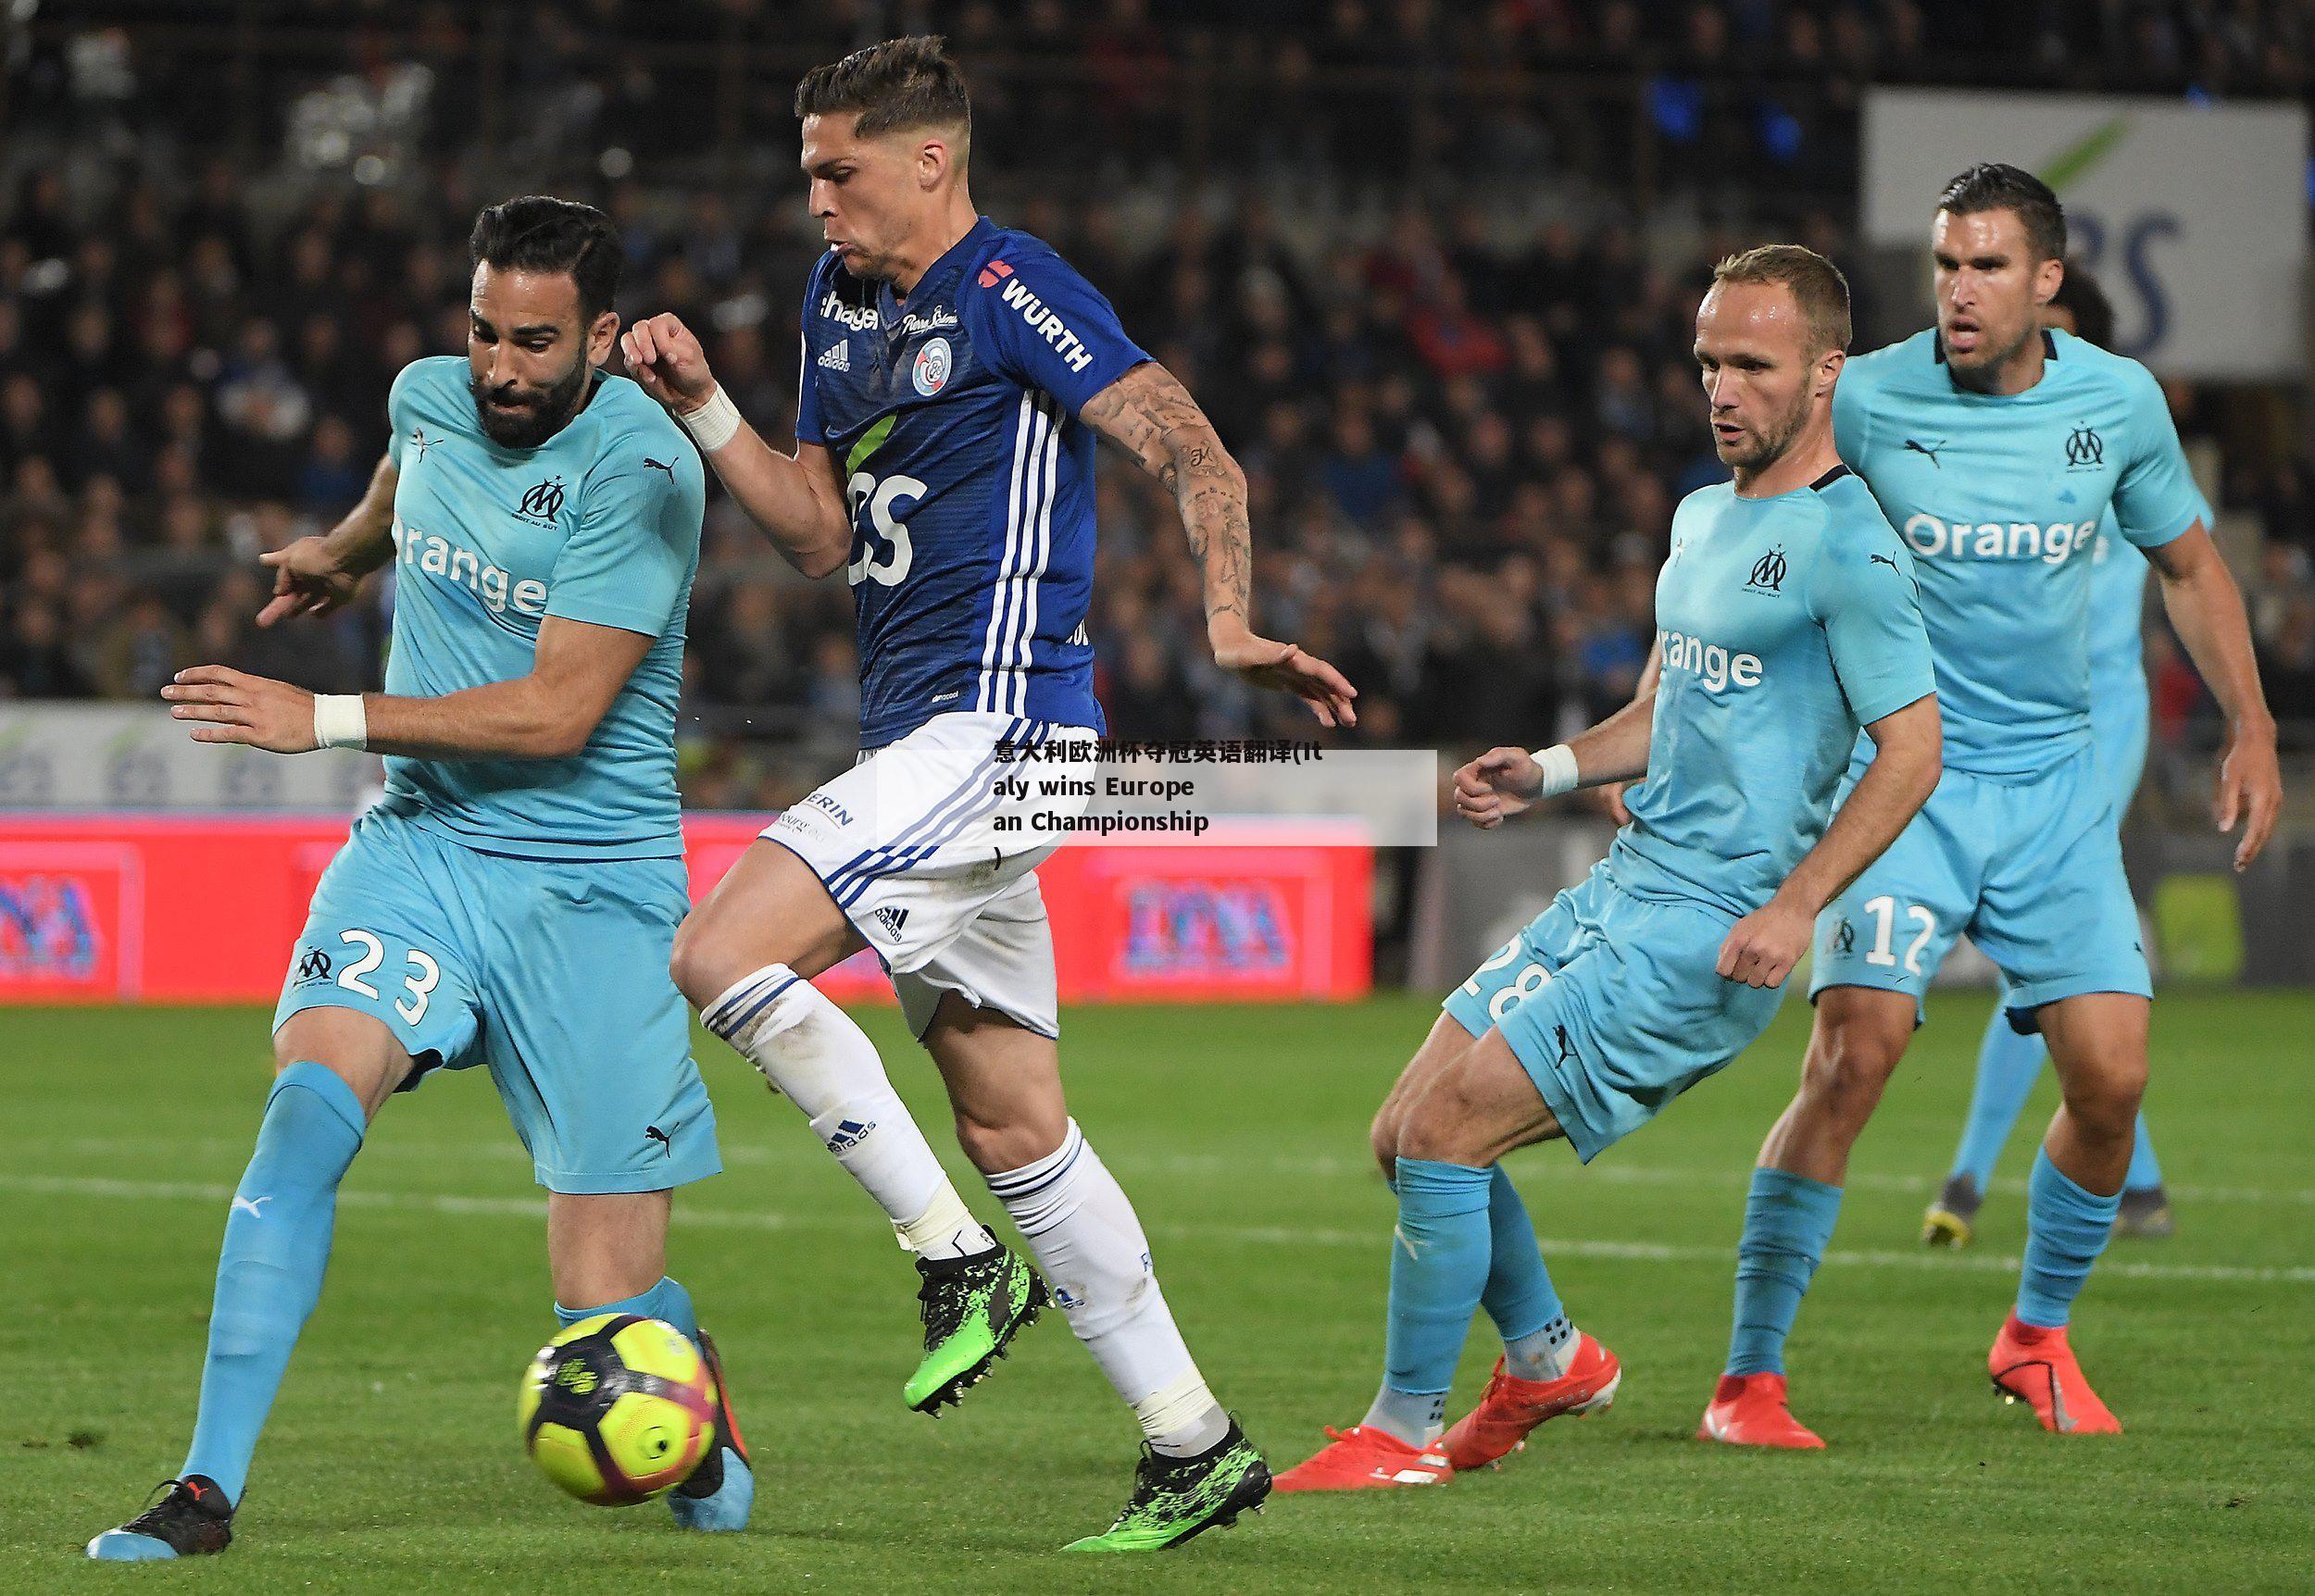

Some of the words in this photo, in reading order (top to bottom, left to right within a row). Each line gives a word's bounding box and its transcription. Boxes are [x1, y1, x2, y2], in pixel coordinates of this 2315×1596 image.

[1001, 278, 1094, 373] WÜRTH
[818, 355, 851, 372] adidas
[1904, 513, 2110, 565] Orange
[1658, 625, 1763, 692] range
[874, 908, 903, 943] adidas
[1864, 894, 1936, 978] 12
[336, 927, 441, 1027] 23
